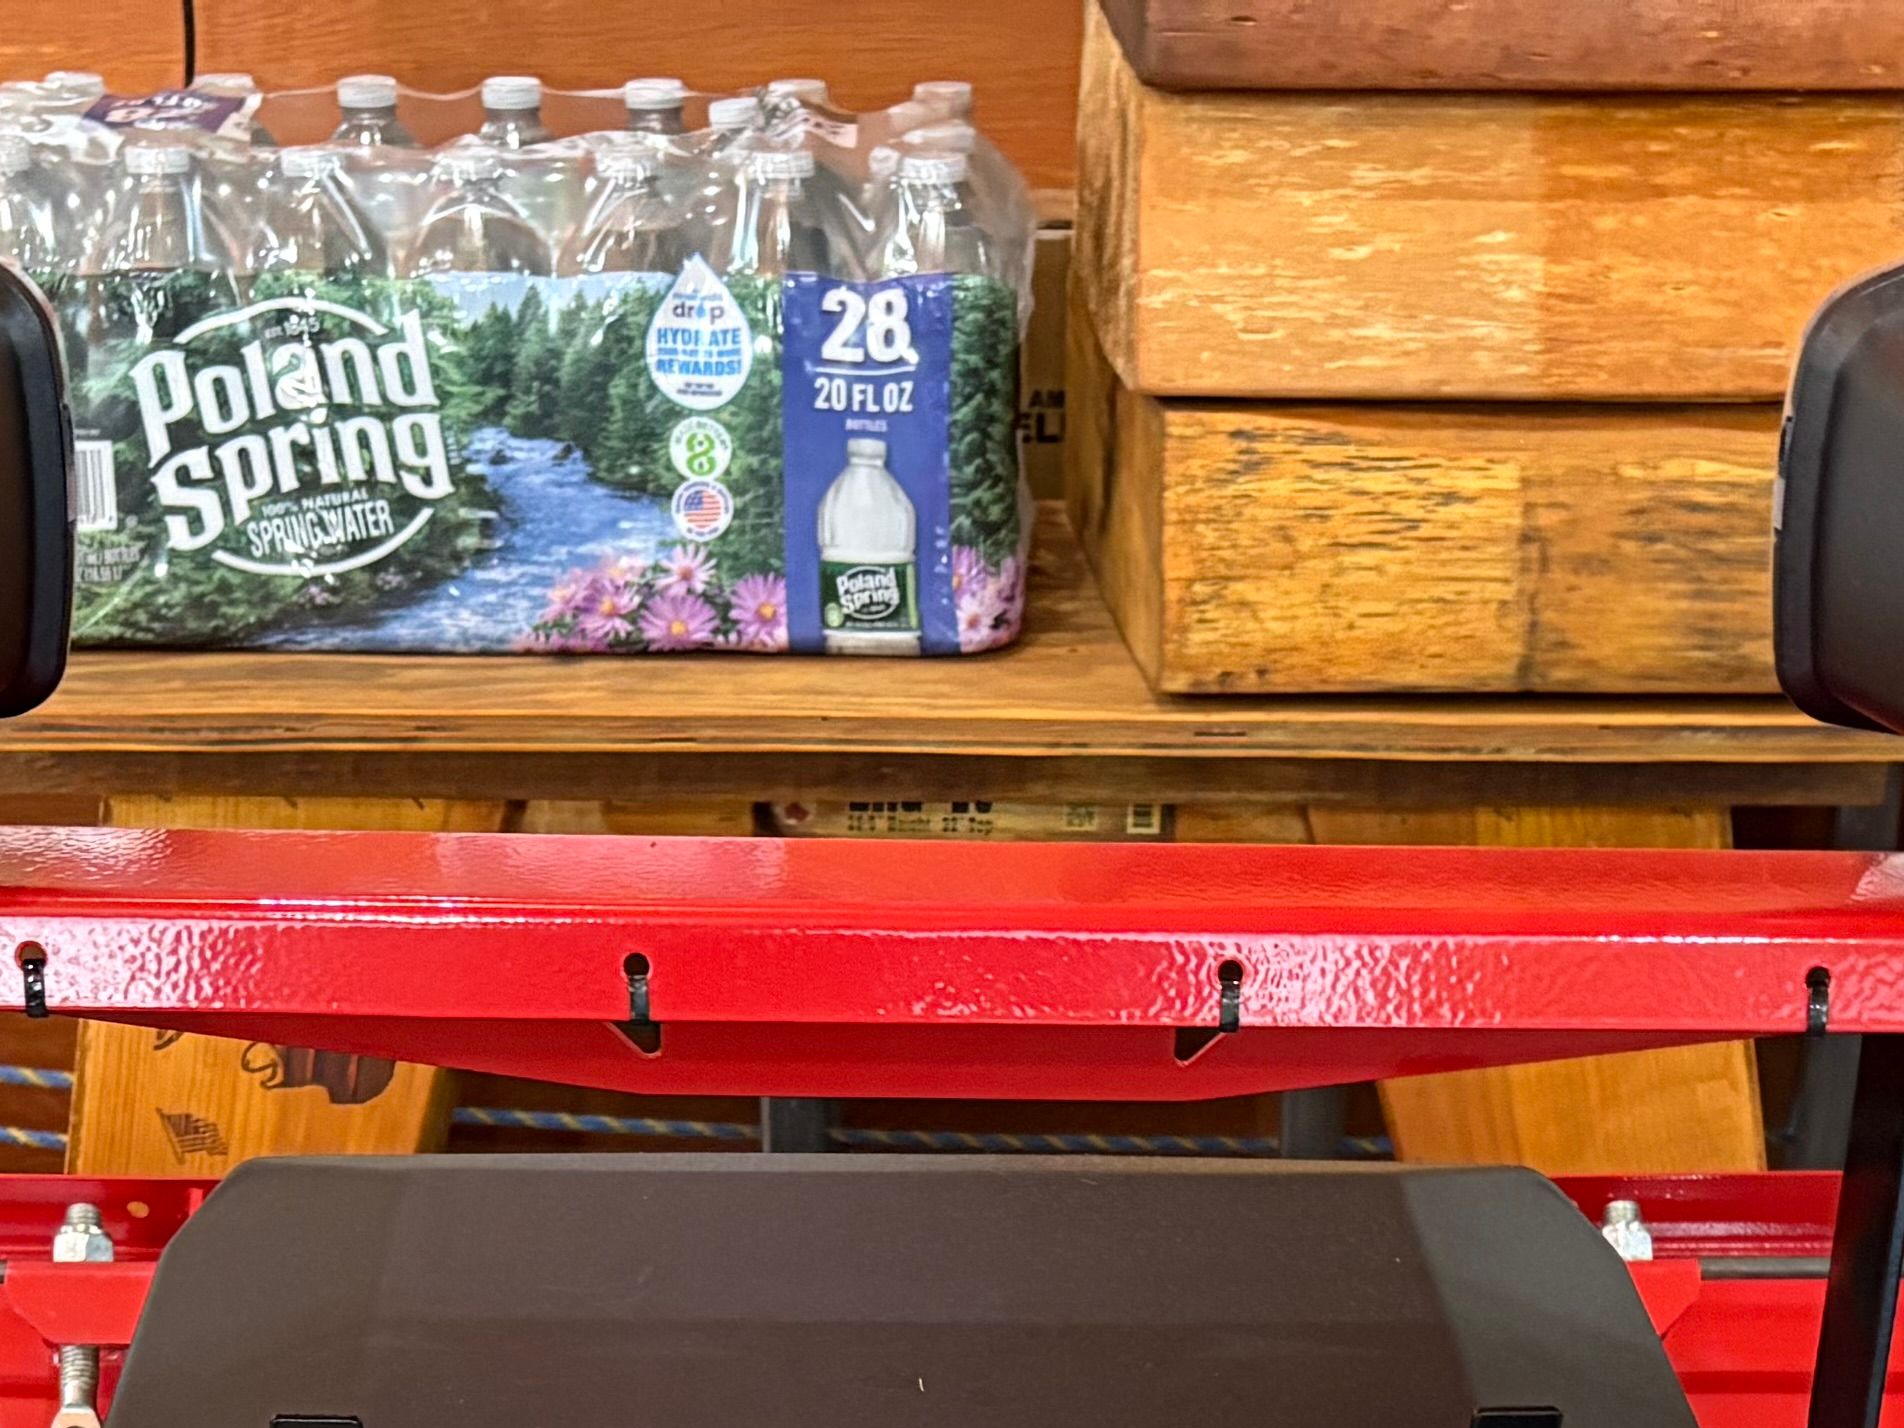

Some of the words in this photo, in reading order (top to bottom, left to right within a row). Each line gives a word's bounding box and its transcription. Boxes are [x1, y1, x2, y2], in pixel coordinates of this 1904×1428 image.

[821, 288, 919, 363] 28
[129, 308, 440, 469] Poland
[814, 377, 846, 410] 20
[852, 384, 879, 412] FL
[884, 381, 913, 412] OZ
[150, 412, 455, 551] Spring
[247, 508, 321, 558] SPRING
[324, 500, 394, 546] WATER
[836, 568, 895, 596] Poland
